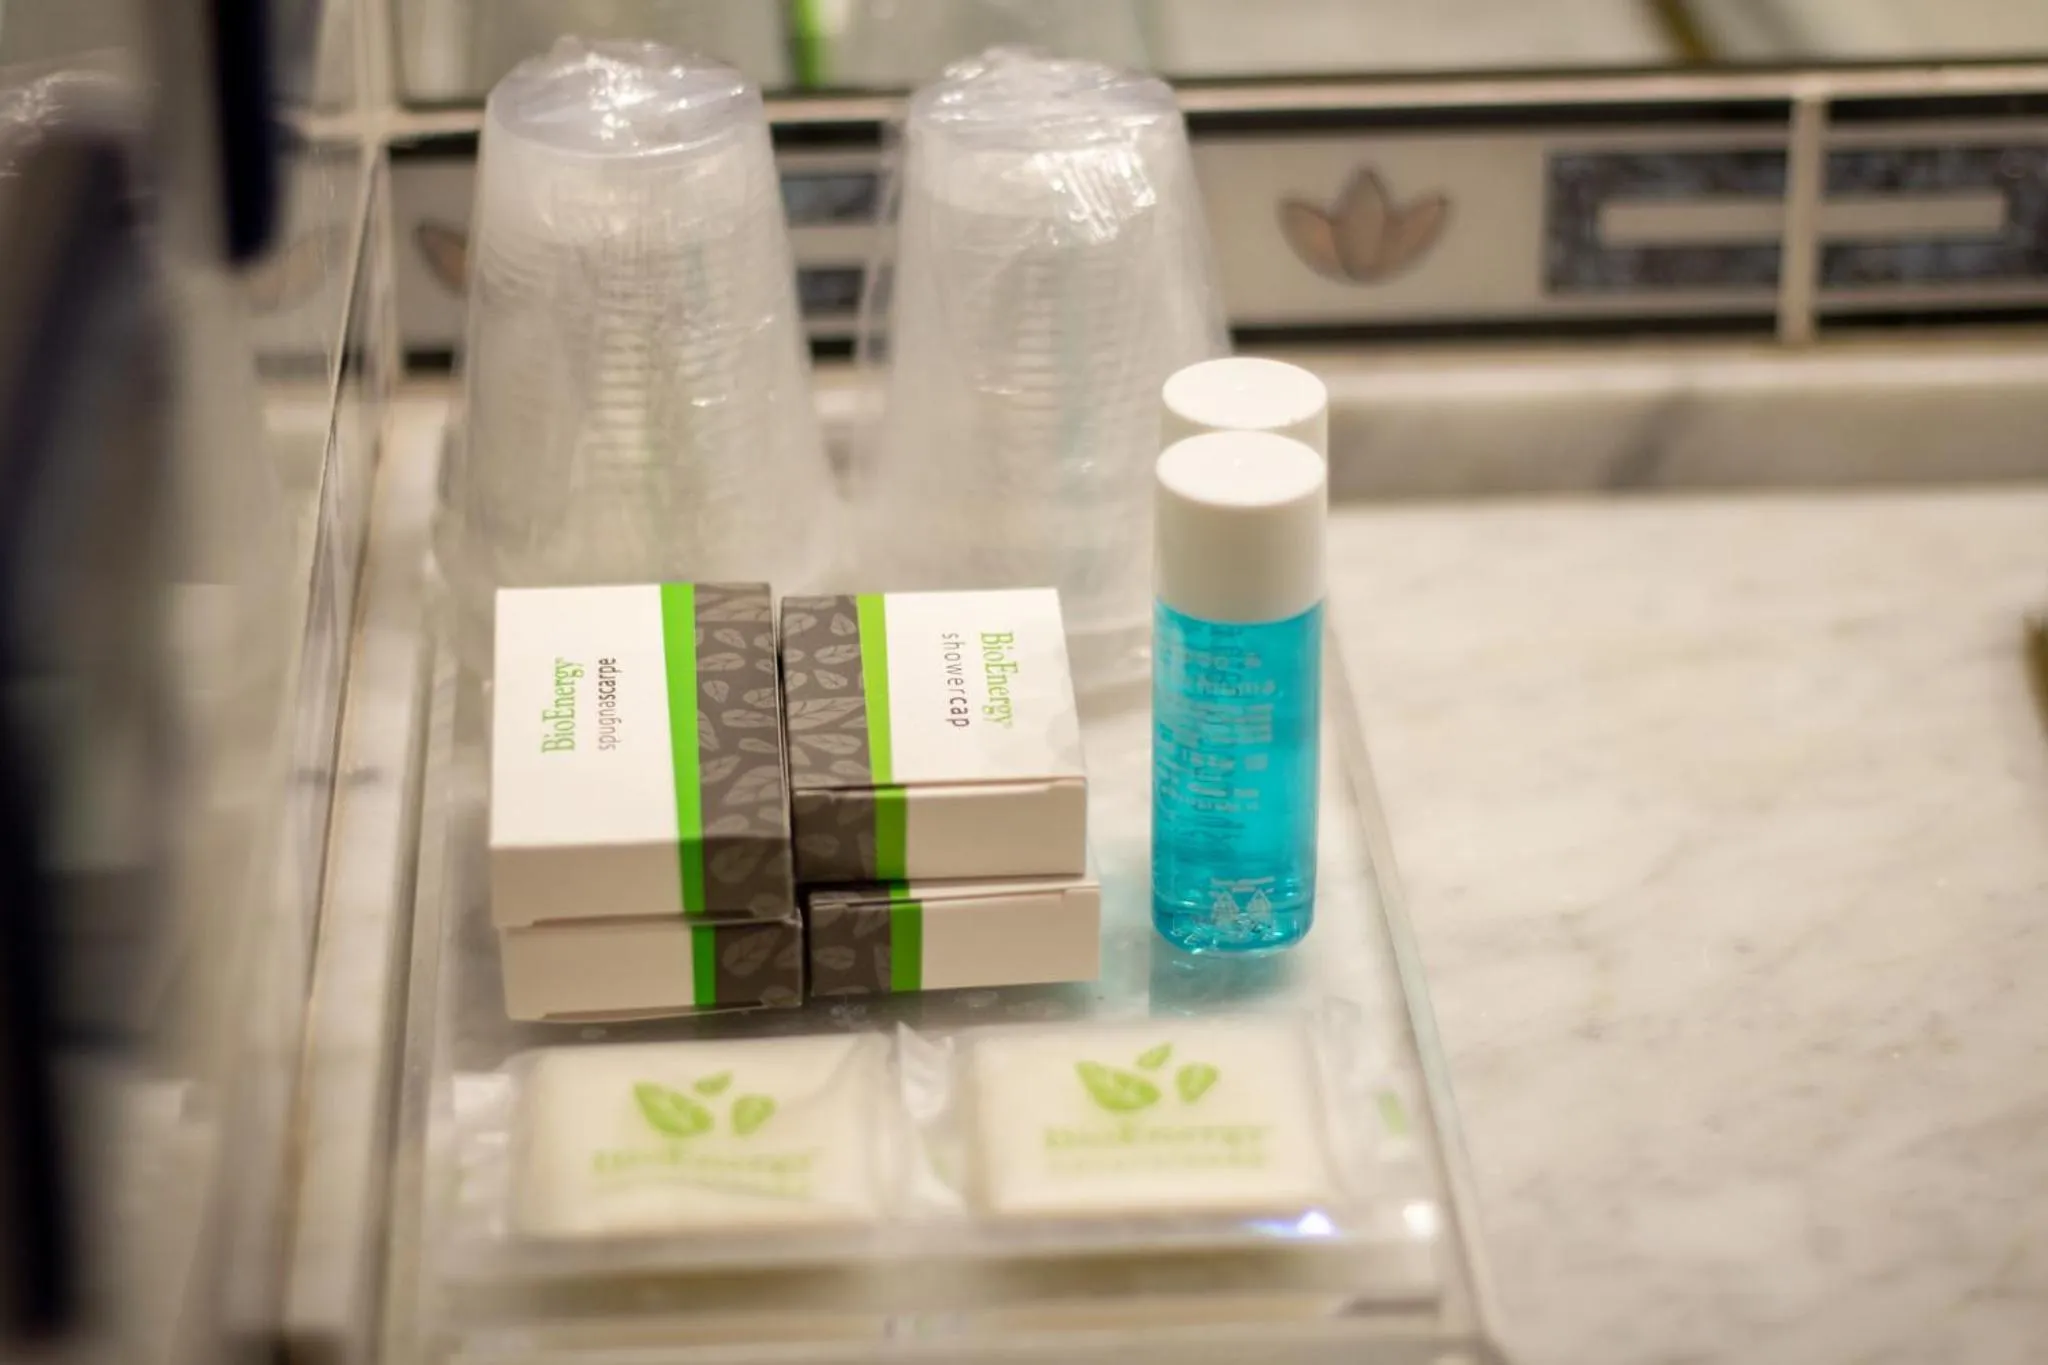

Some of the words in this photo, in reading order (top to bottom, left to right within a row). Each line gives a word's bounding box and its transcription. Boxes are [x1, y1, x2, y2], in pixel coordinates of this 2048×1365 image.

[541, 660, 583, 754] BioEnergy
[597, 656, 622, 752] spugnascarpe
[941, 632, 970, 728] showercap
[982, 631, 1017, 727] BioEnergy
